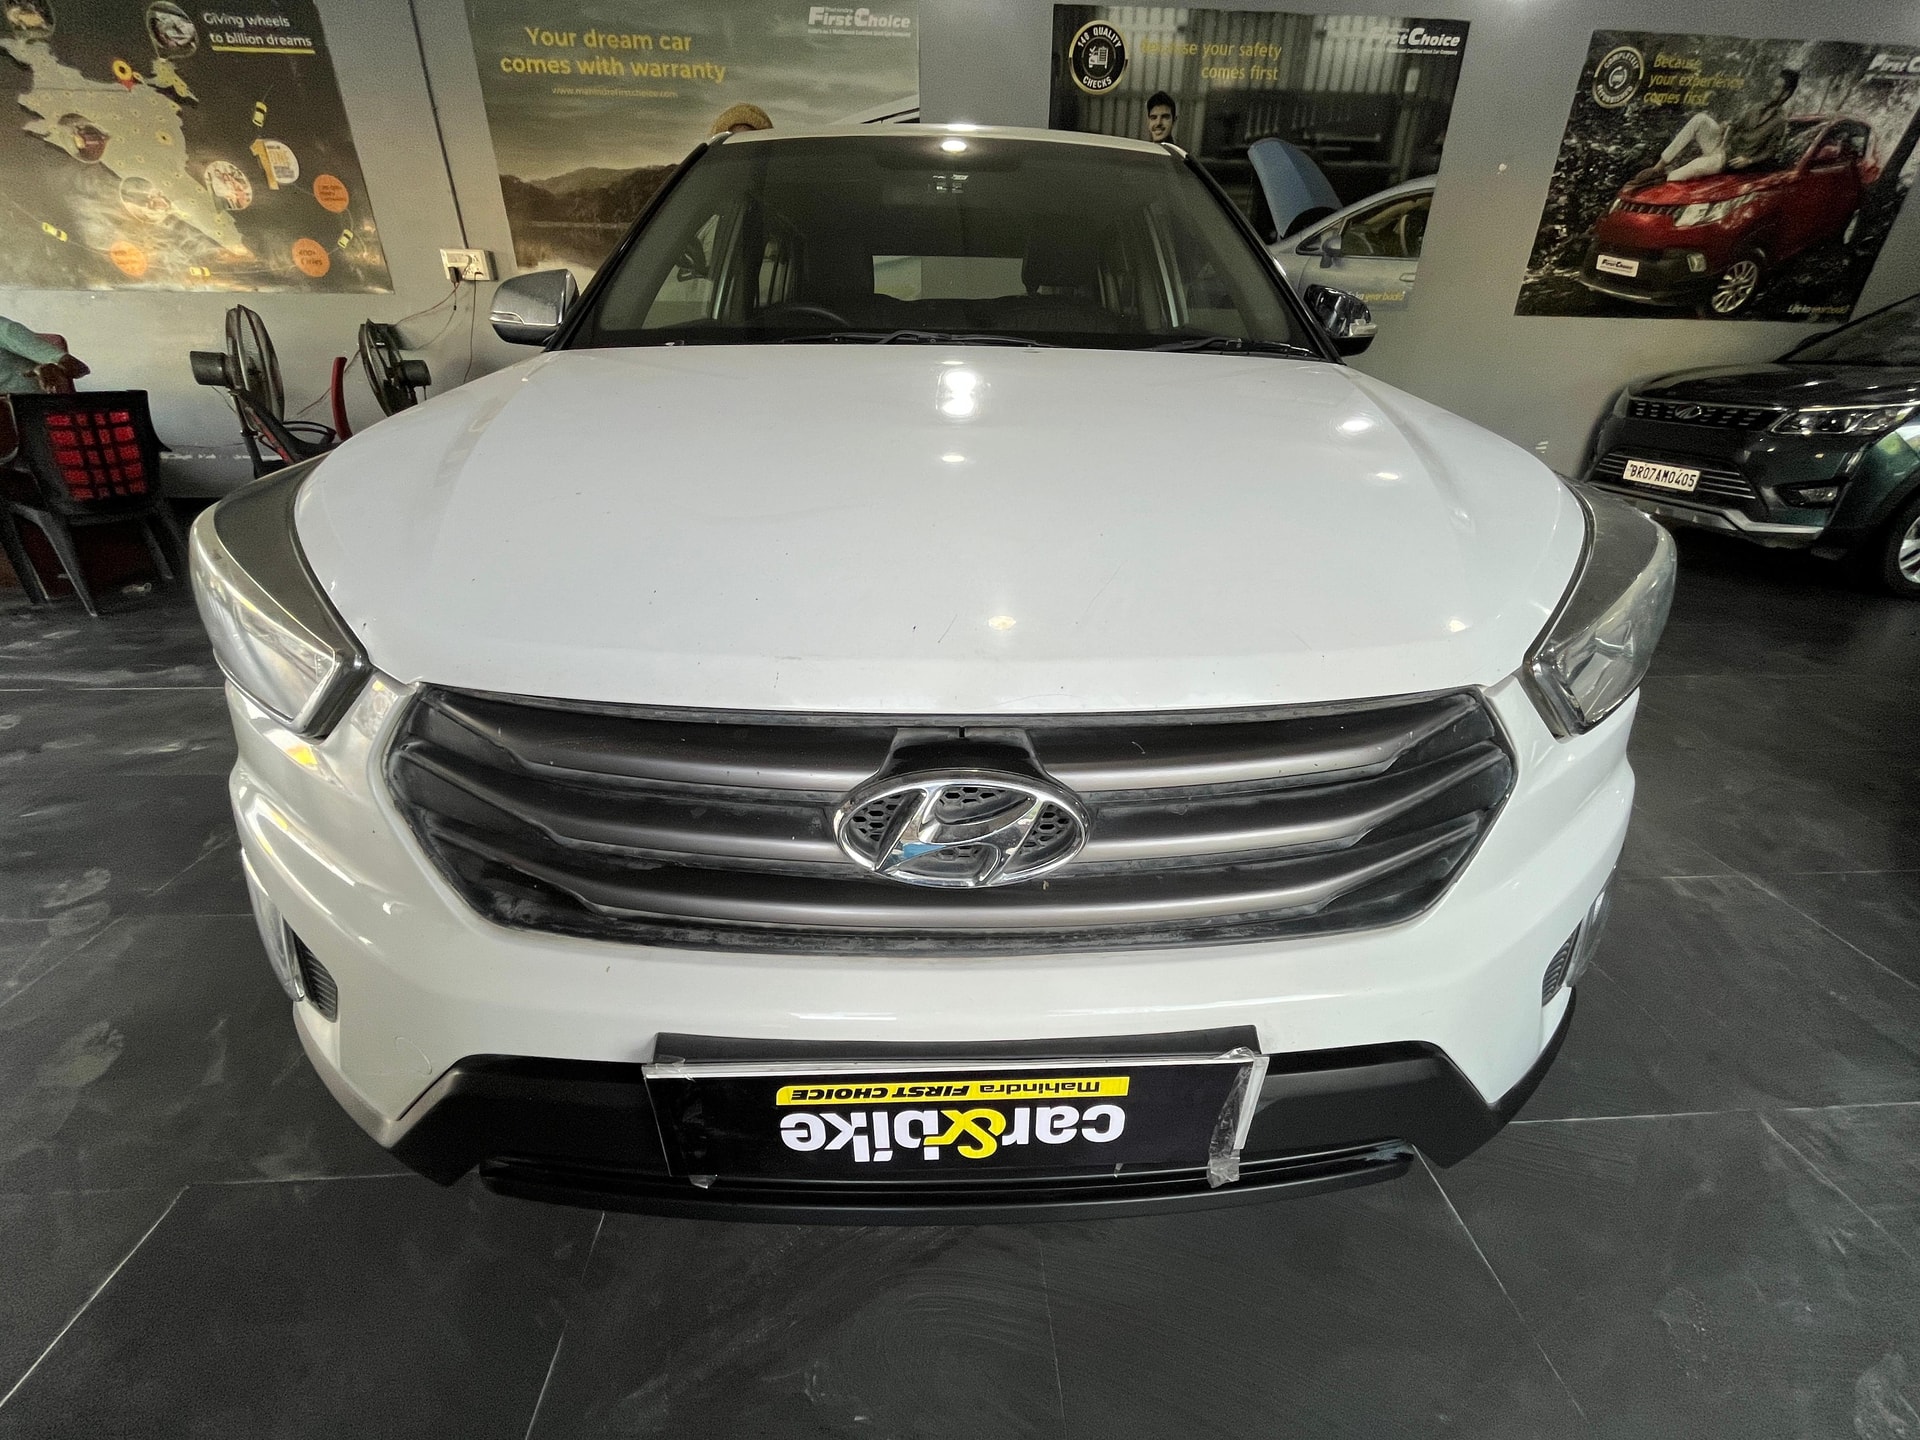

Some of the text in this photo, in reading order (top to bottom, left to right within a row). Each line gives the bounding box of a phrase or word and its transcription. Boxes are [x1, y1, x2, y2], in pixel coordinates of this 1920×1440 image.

[203, 12, 291, 28] Giving wheels
[210, 32, 313, 47] to billion dreams
[525, 27, 692, 51] Your dream car
[1093, 26, 1122, 48] QUALITY
[1202, 43, 1235, 58] your
[1239, 42, 1282, 61] safety
[501, 56, 726, 83] comes with warranty
[1653, 52, 1702, 70] Because
[1201, 65, 1279, 80] comes first
[1648, 74, 1677, 88] your
[1082, 76, 1112, 88] CHECKS
[1643, 91, 1714, 106] comes first
[1630, 464, 1697, 488] BR07AM0405
[791, 1081, 1100, 1101] Mahindra FIRST CHOICE
[780, 1104, 1126, 1163] car&bike
